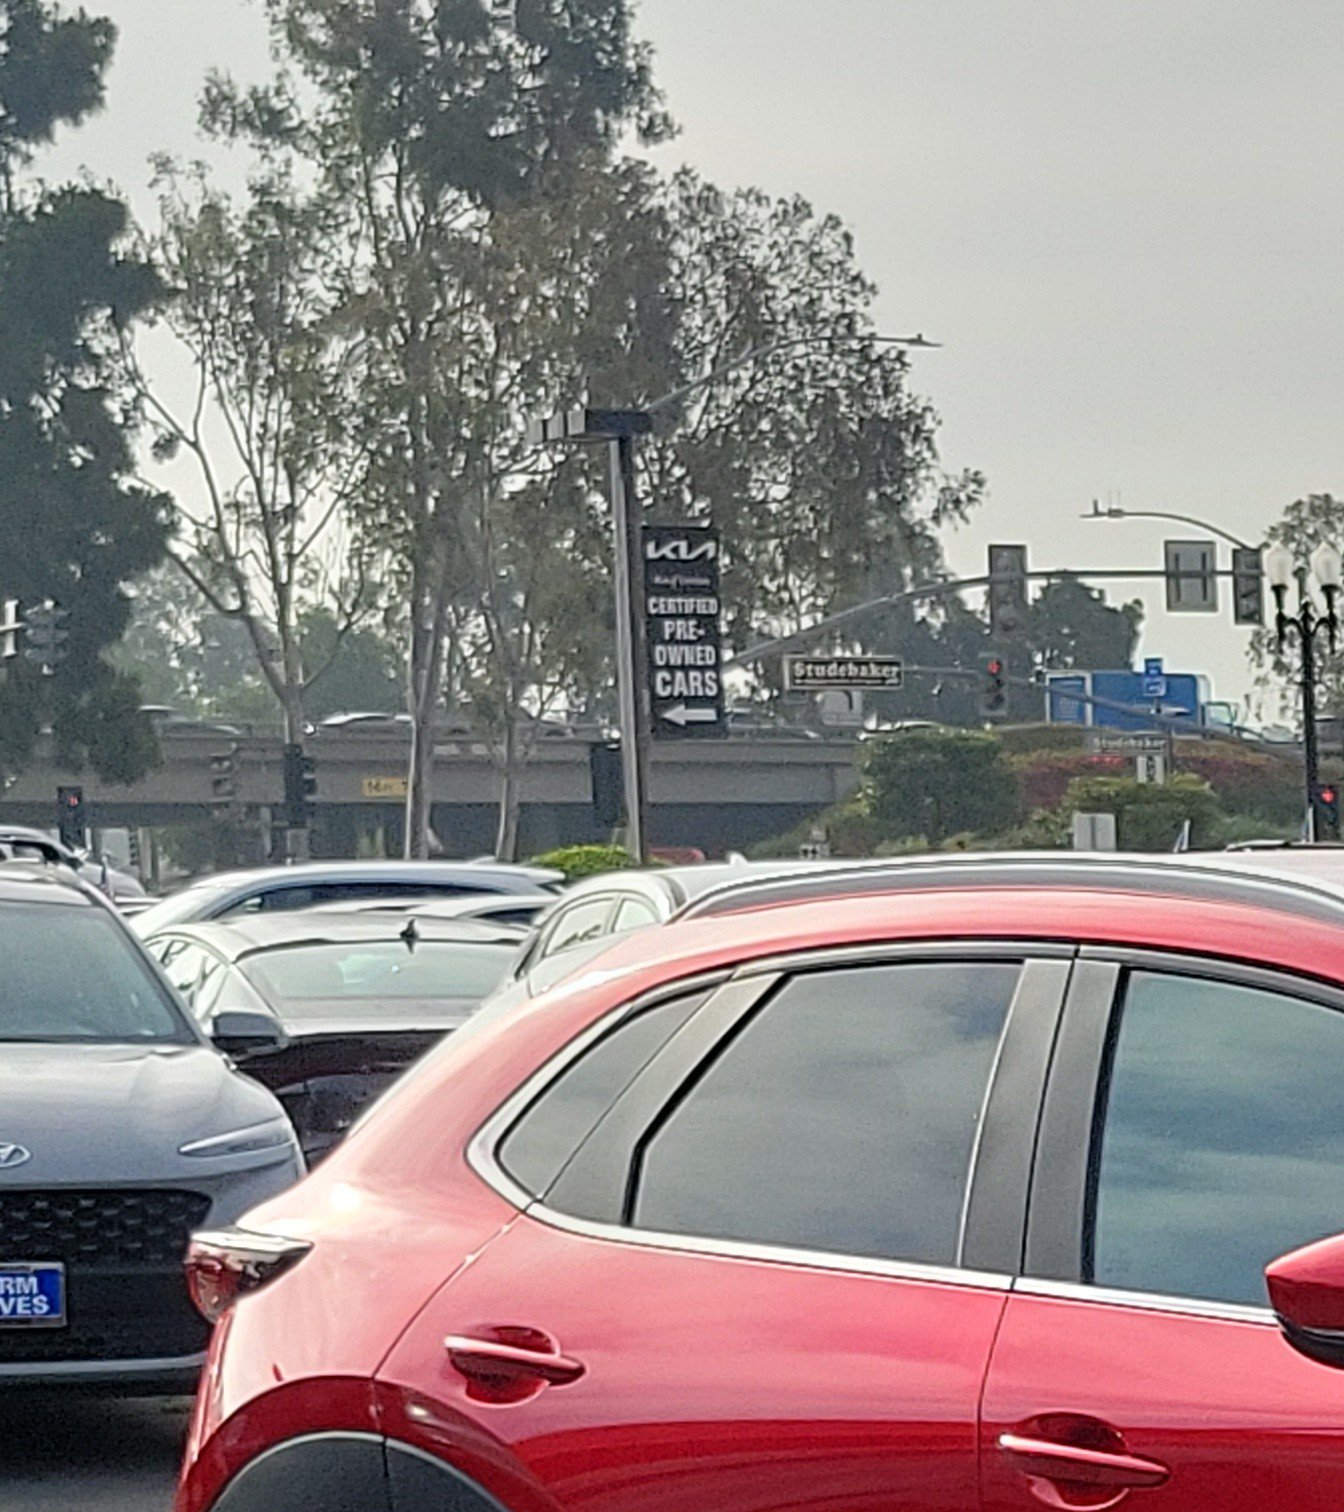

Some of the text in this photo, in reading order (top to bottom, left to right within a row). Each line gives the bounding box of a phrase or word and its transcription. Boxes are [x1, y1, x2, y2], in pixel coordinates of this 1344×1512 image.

[646, 540, 716, 560] KIA
[649, 597, 718, 614] CERTIFIED
[664, 620, 706, 640] PRE-
[655, 645, 716, 666] OWNED
[794, 662, 898, 678] Studebaker
[655, 671, 718, 696] CARS
